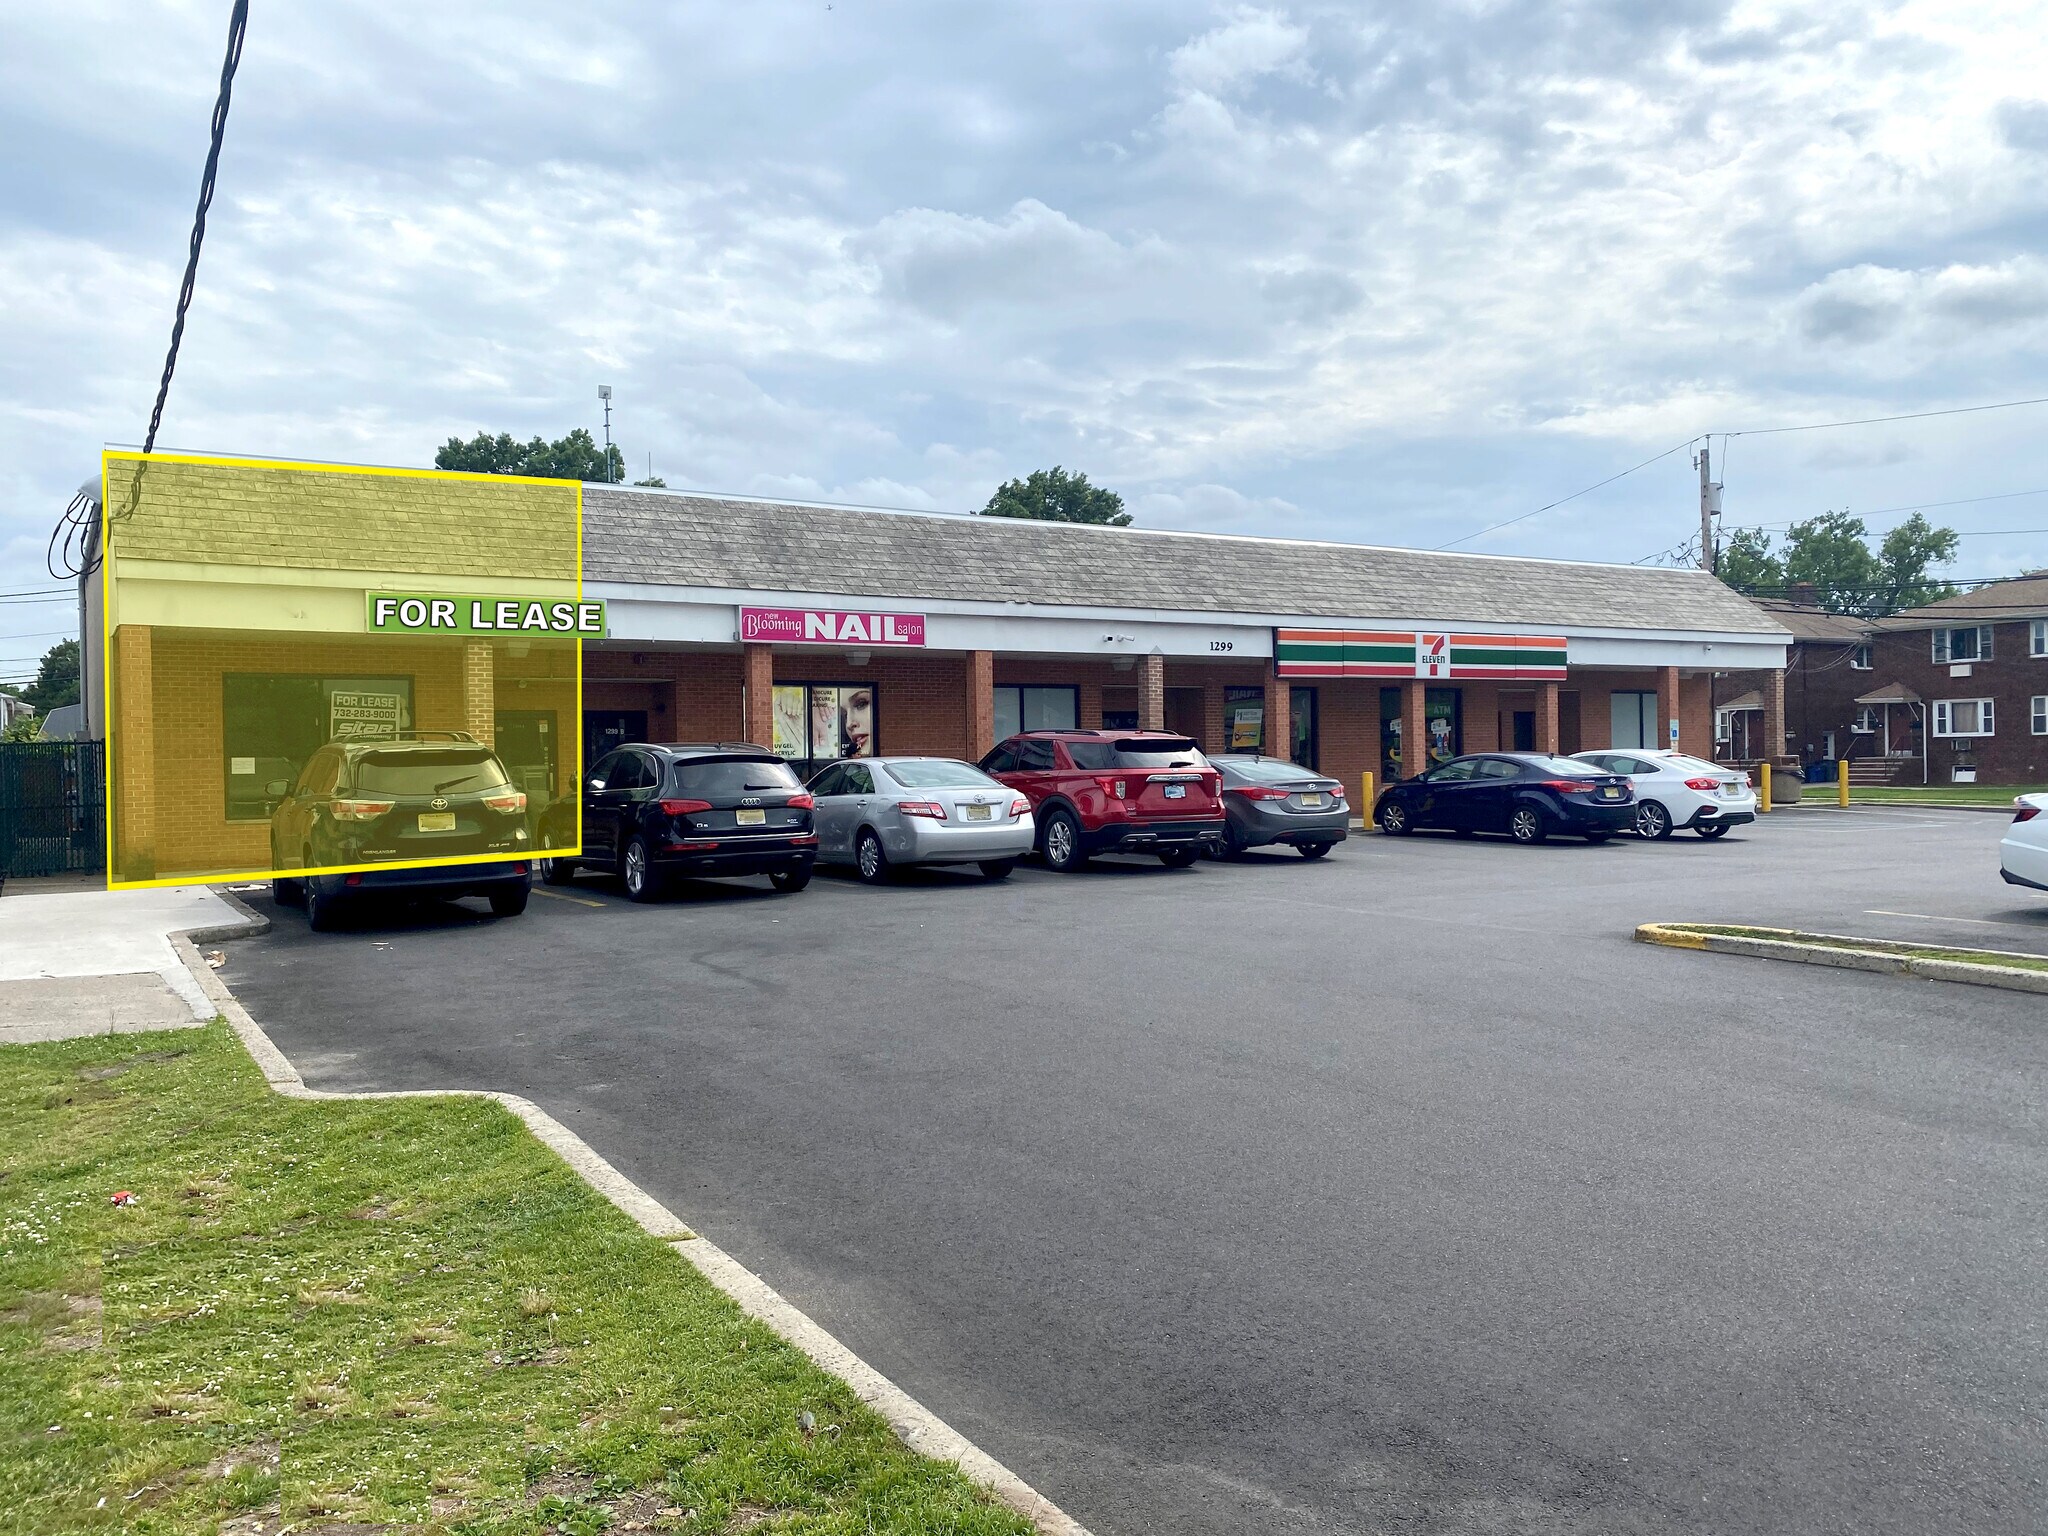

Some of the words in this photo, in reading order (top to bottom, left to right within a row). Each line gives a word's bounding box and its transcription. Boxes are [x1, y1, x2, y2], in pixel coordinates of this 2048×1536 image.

[743, 614, 802, 638] Blooming
[804, 612, 909, 642] NAIL
[897, 622, 922, 636] salon
[1209, 641, 1233, 652] 1299
[1422, 634, 1445, 676] 7
[336, 695, 358, 706] FOR
[361, 697, 395, 708] LEASE
[334, 708, 396, 719] 732-283-9000
[1433, 705, 1451, 715] ATM
